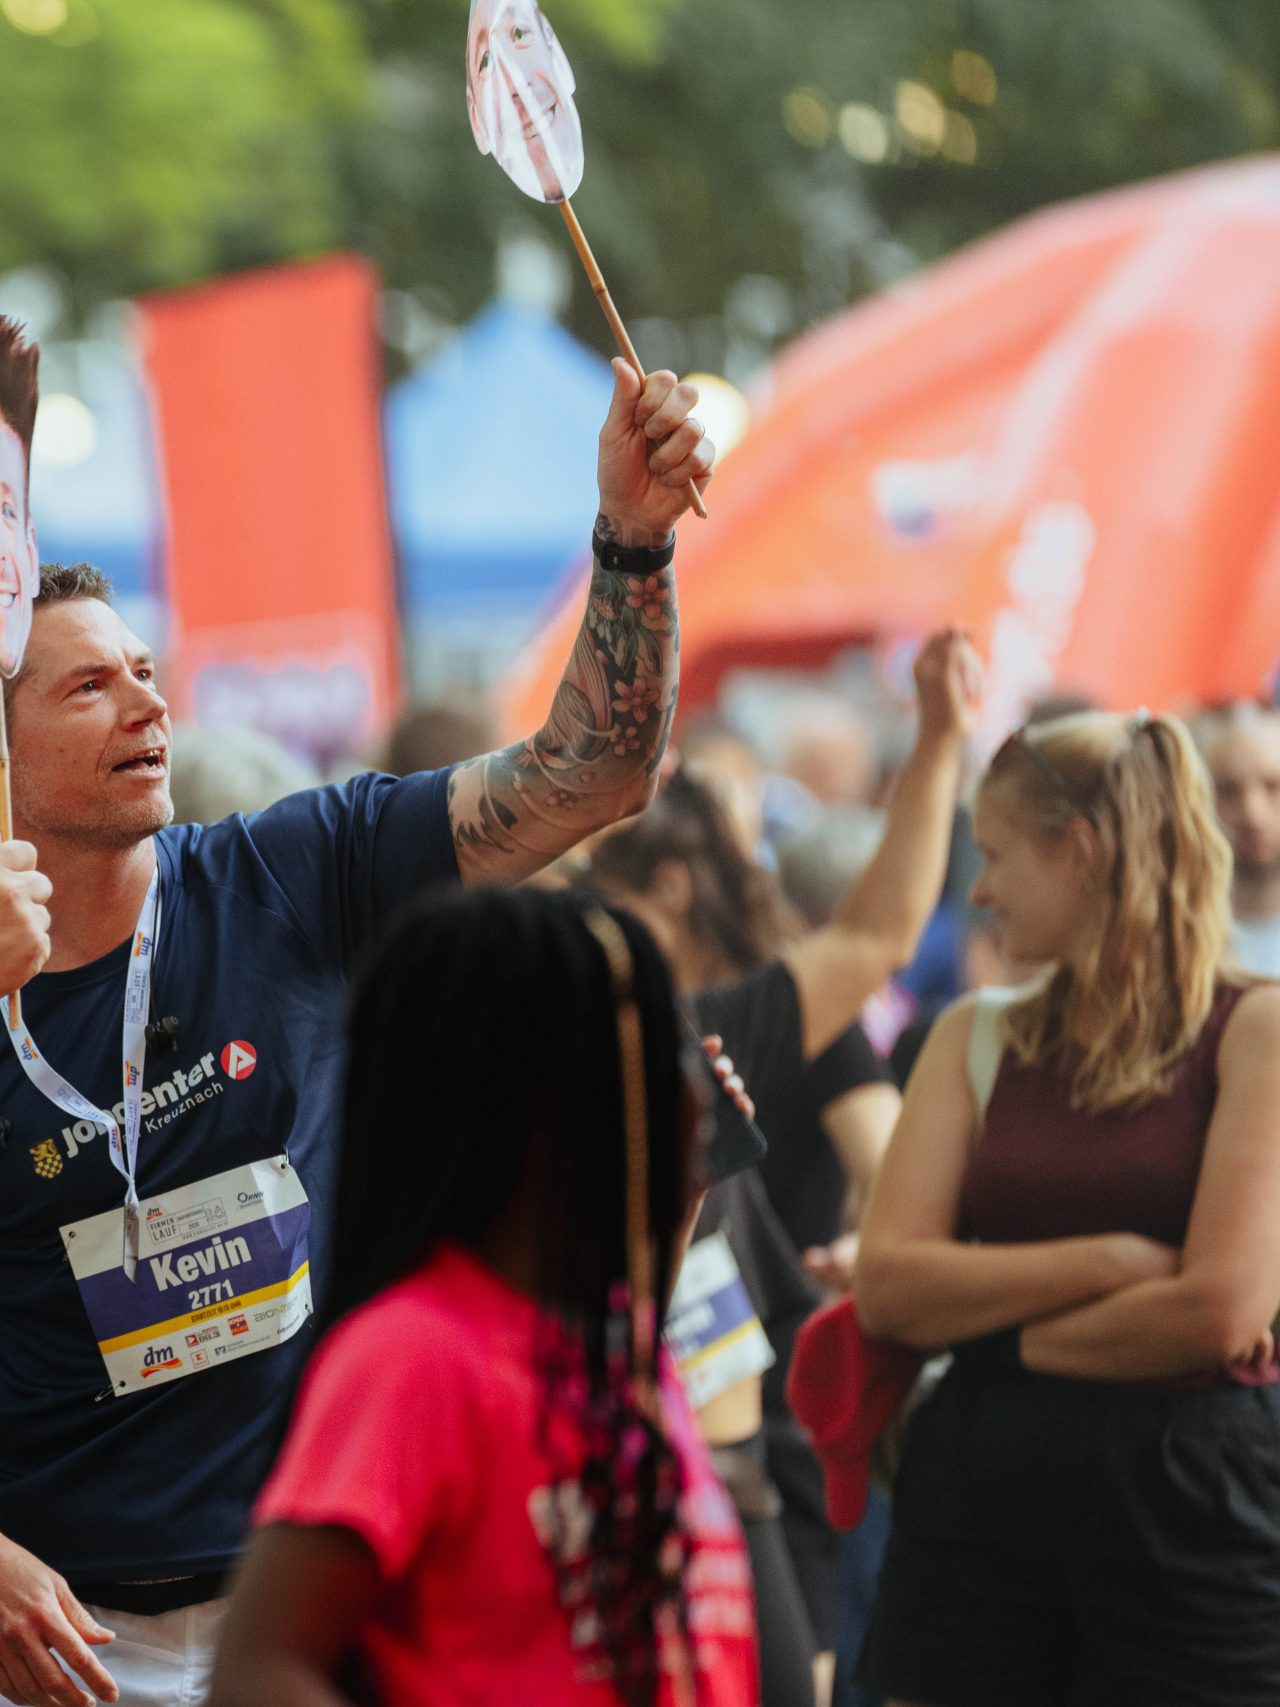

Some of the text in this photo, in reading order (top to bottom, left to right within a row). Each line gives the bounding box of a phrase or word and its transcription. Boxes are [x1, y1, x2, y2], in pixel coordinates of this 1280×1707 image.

[139, 936, 154, 956] dm
[20, 1042, 33, 1061] dm
[129, 1065, 140, 1086] dm
[144, 1081, 224, 1134] Kreuznach
[147, 1206, 160, 1217] dm
[150, 1217, 175, 1231] FIRMEN
[152, 1225, 177, 1241] LAUF
[148, 1235, 253, 1292] Kevin
[187, 1278, 235, 1311] 2771
[143, 1344, 174, 1368] dm
